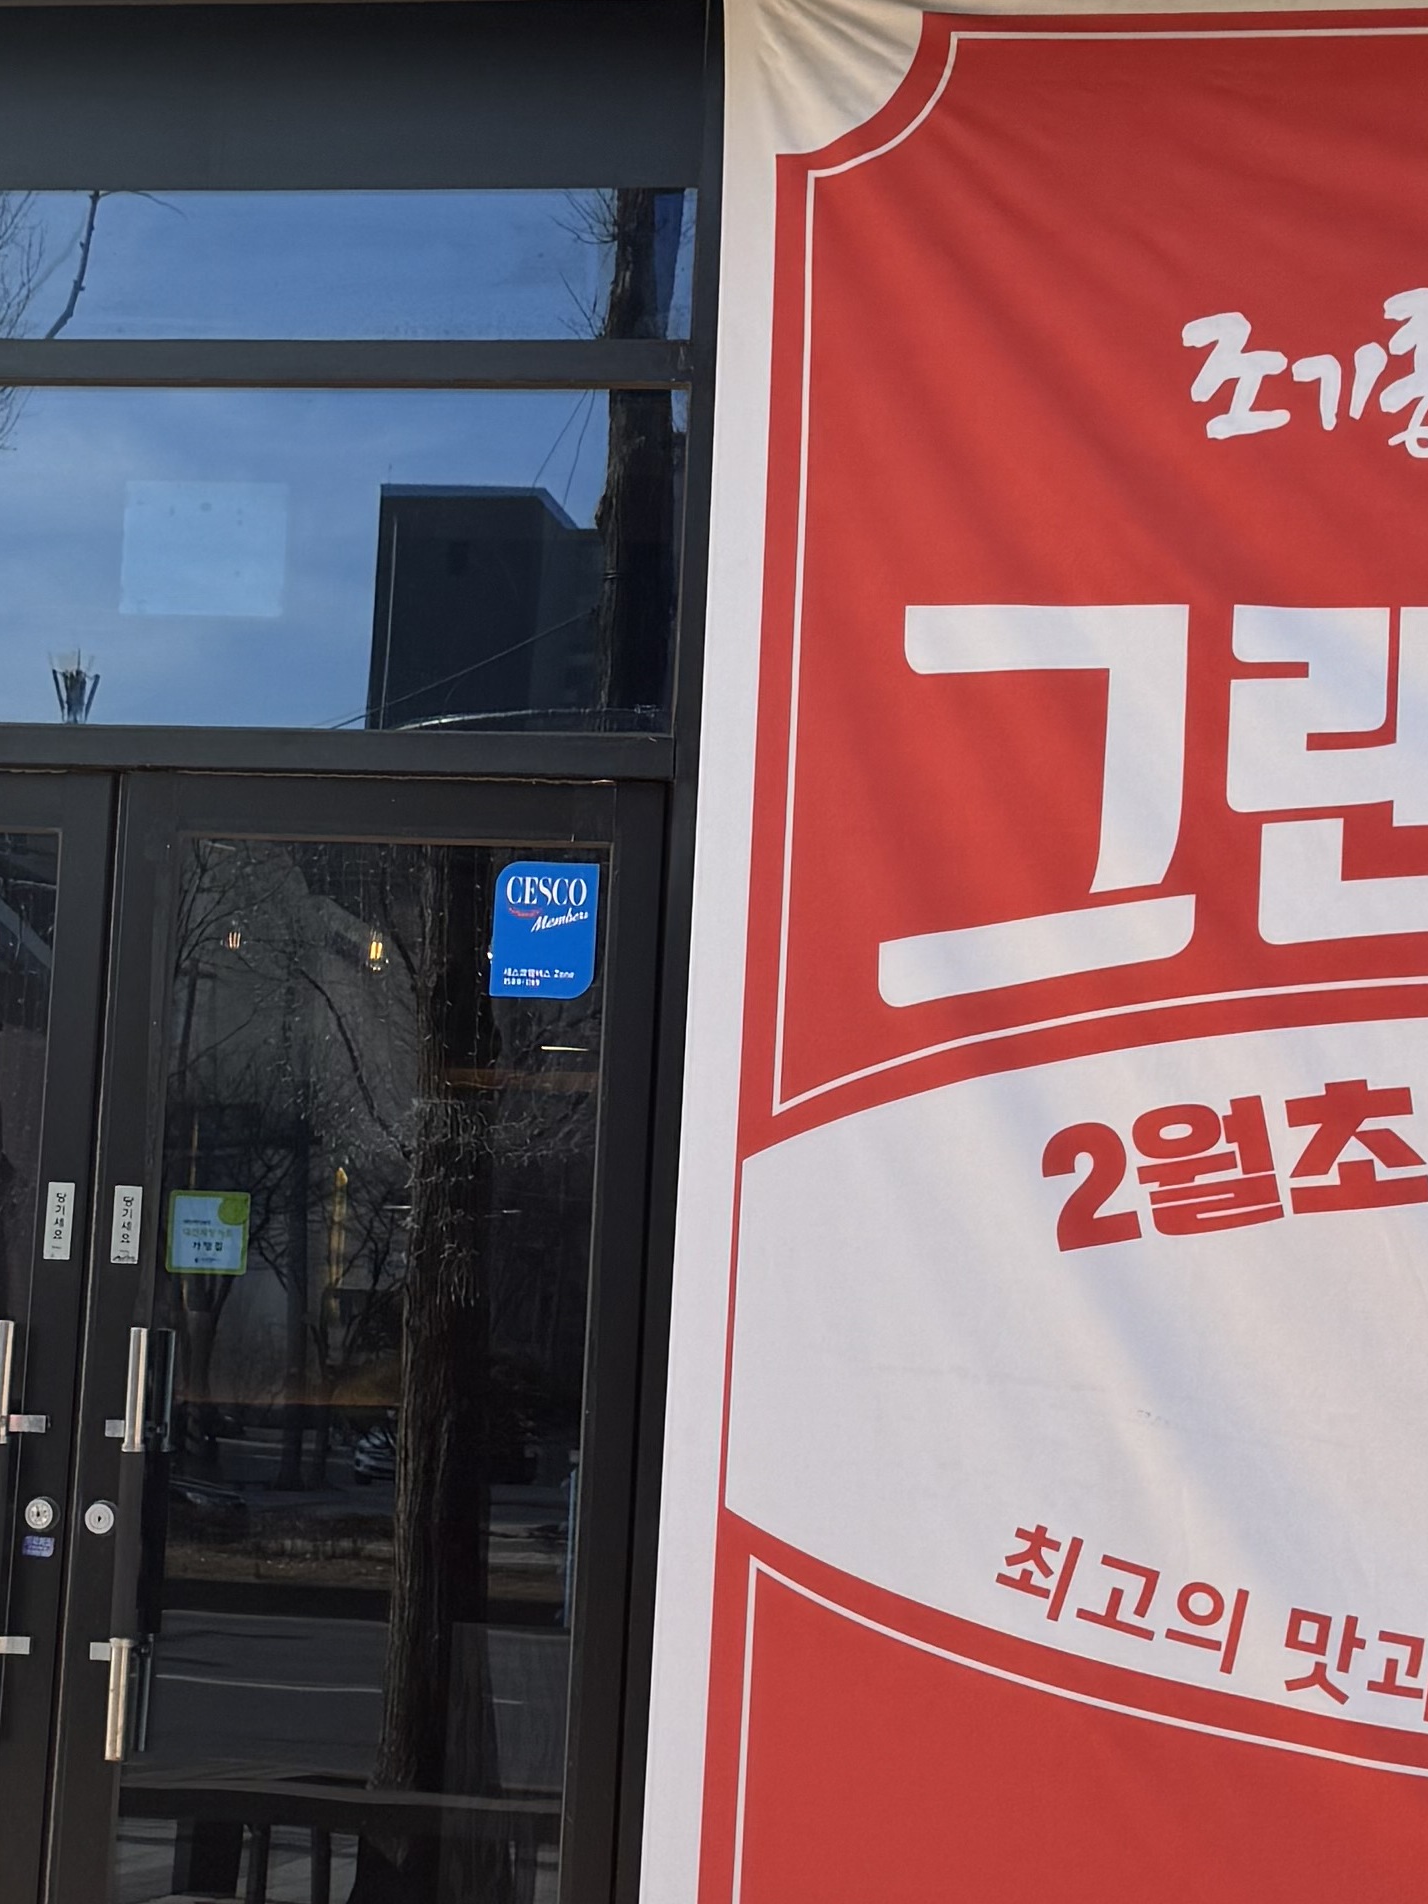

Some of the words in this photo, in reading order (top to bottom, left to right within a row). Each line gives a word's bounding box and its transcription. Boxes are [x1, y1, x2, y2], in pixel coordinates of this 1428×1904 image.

[506, 875, 587, 907] CESCO
[53, 1192, 67, 1240] 당기세요
[119, 1196, 135, 1244] 당기세요
[996, 1525, 1254, 1676] 최고의
